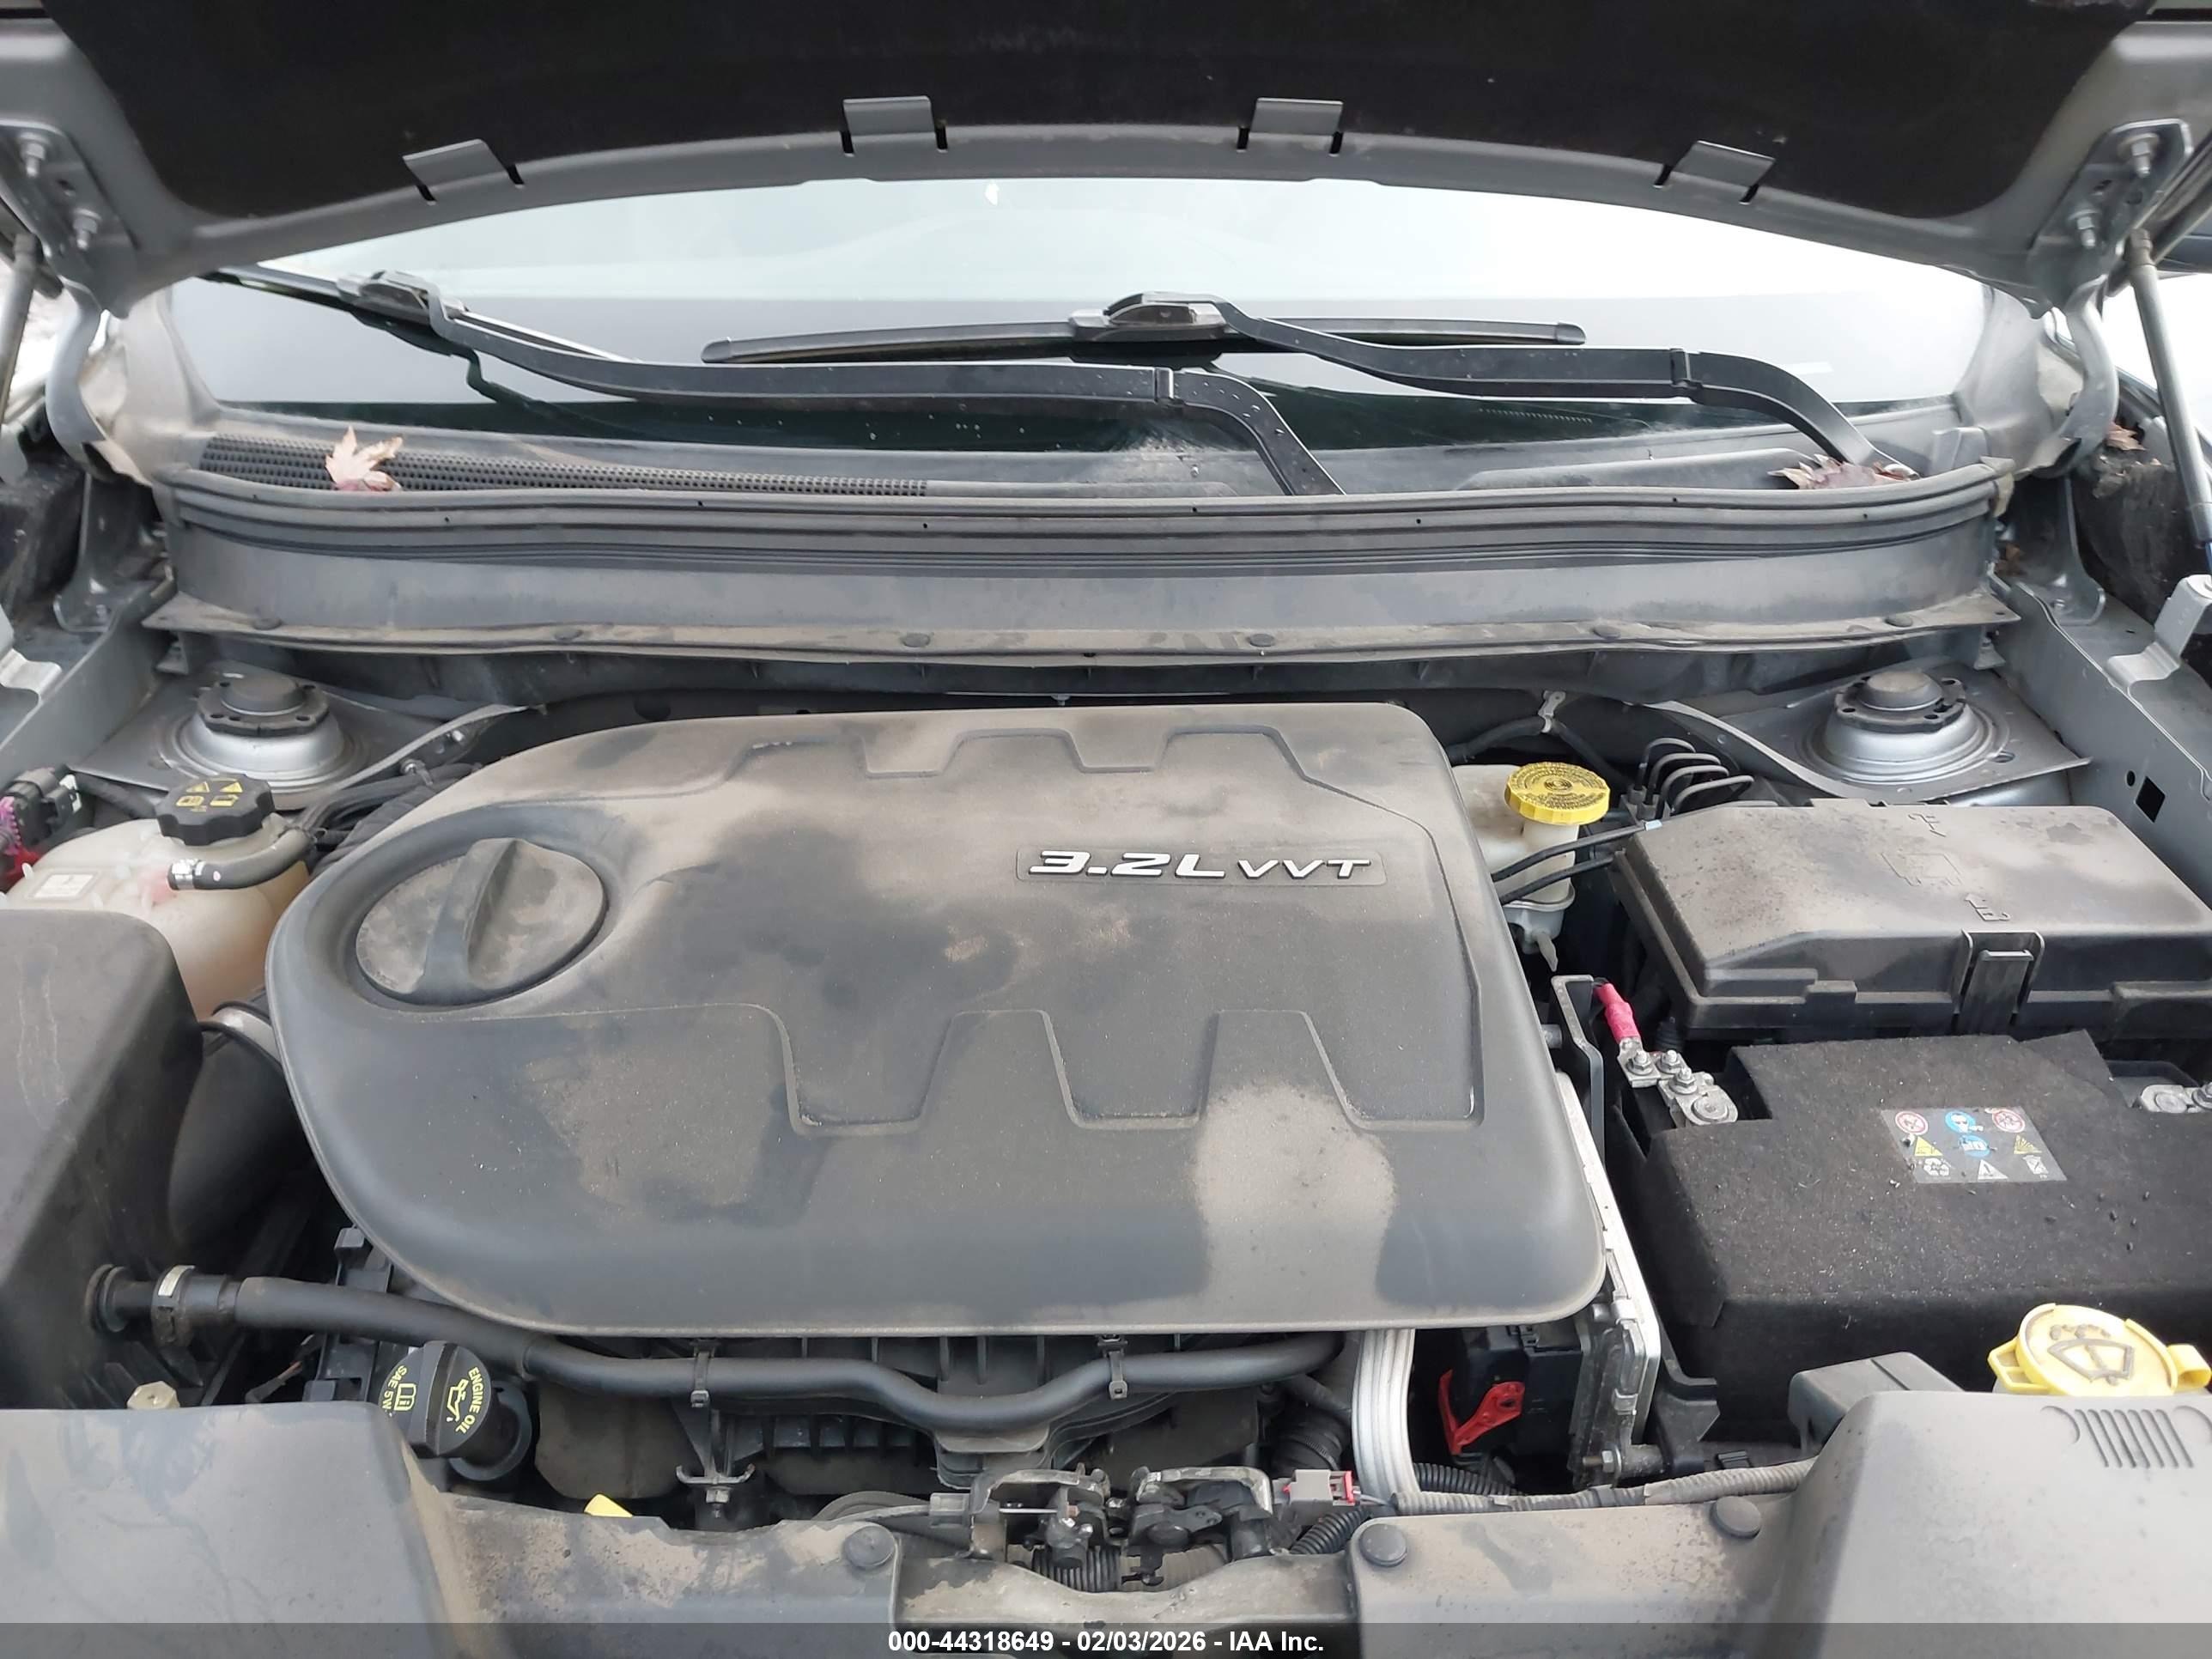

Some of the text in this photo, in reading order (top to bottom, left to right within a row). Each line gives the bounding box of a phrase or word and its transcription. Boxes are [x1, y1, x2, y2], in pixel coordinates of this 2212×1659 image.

[1029, 850, 1371, 880] 3.2L VVT
[388, 1365, 407, 1389] SAE
[456, 1367, 483, 1433] ENGINE OIL
